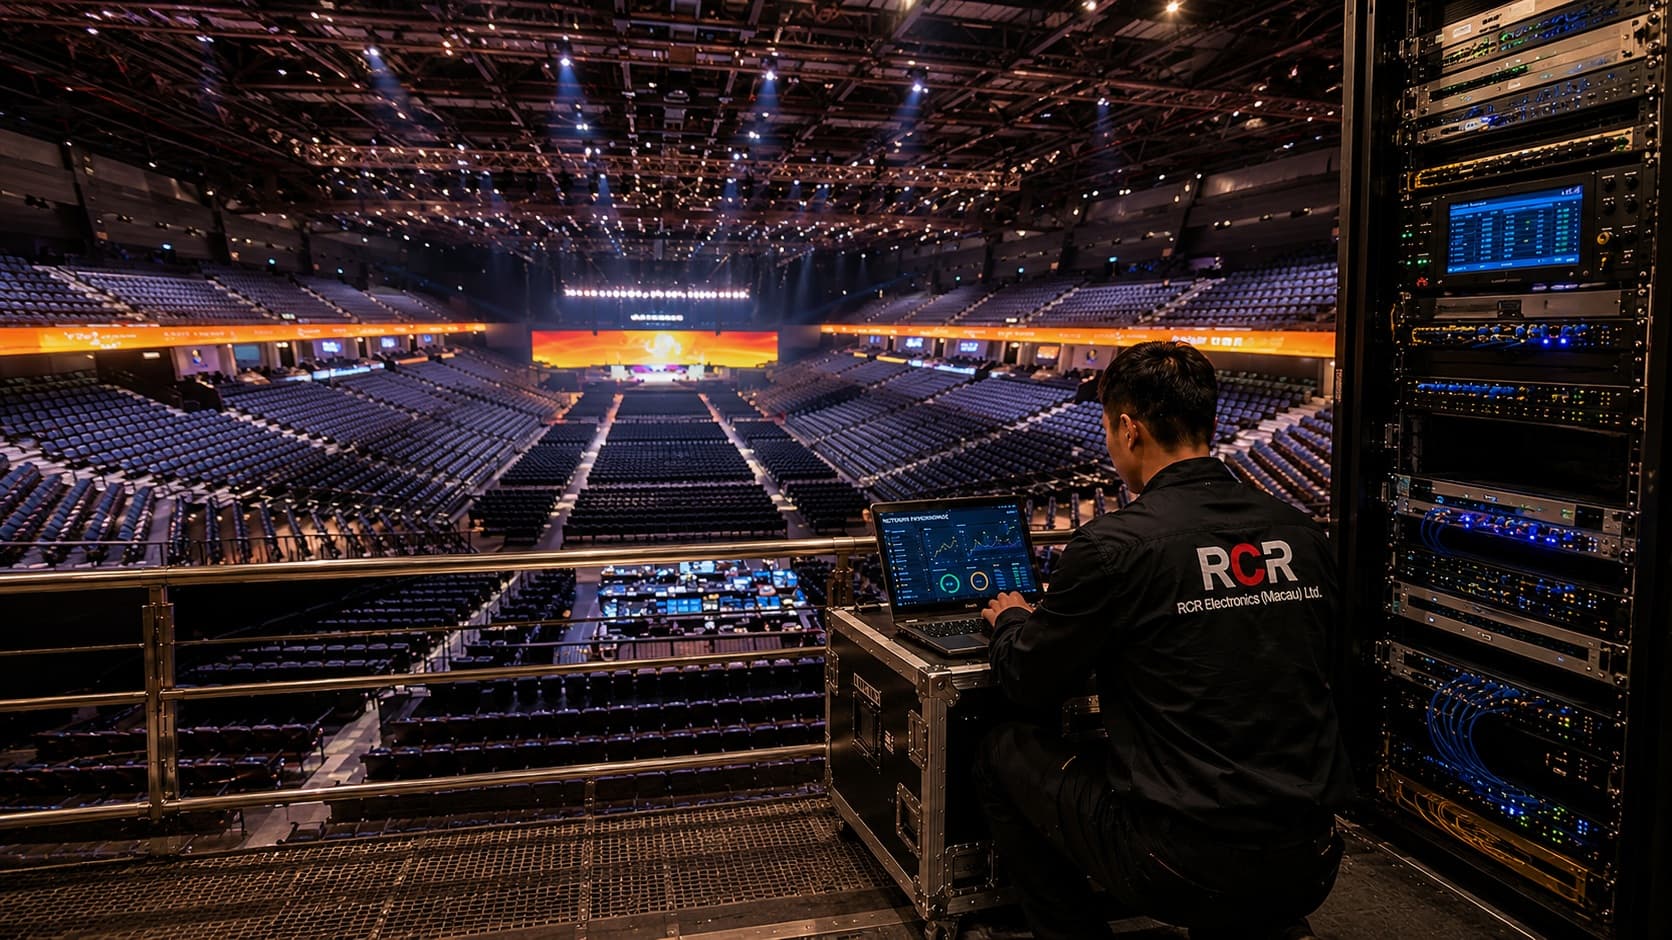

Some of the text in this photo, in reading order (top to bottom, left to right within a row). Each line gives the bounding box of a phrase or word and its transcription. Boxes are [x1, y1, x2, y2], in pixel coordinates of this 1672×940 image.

[1196, 540, 1298, 591] RCR
[1177, 585, 1323, 614] RCR Electronics (Macau) Ltd.
